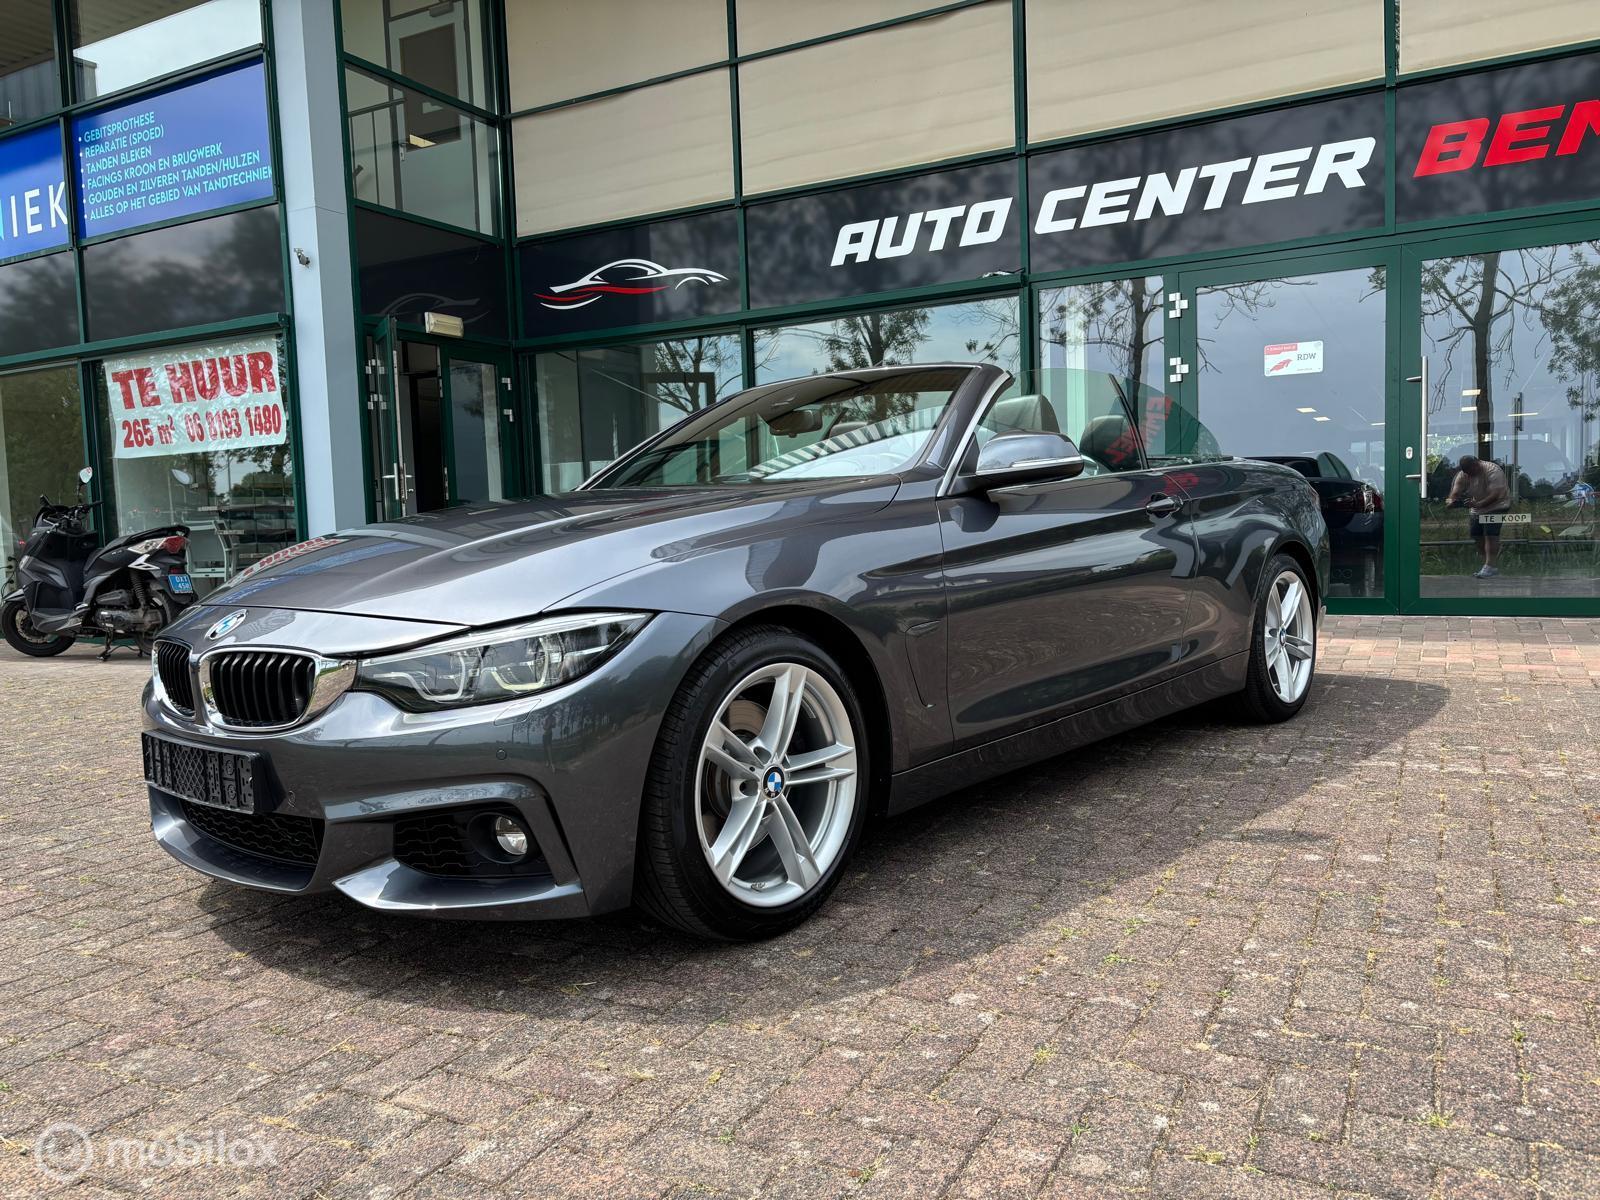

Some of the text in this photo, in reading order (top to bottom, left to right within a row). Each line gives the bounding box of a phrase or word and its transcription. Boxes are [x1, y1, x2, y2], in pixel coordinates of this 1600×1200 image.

[84, 111, 155, 142] GEBITSPROTHESE
[85, 124, 164, 158] REPARATIE (SPOED)
[86, 145, 152, 174] TANDEN BLEKEN
[87, 142, 222, 190] FACINGS KROON EN BRUGWERK
[88, 150, 260, 204] GOUDEN EN ZILVEREN TANDEN/HULZEN
[0, 181, 68, 240] IEK
[90, 204, 114, 221] ALLES
[116, 200, 129, 214] OP
[130, 196, 146, 211] HET
[148, 188, 180, 206] GEBIED
[182, 183, 201, 197] VAN
[830, 197, 1013, 267] AUTO
[1034, 137, 1376, 235] CENTER
[1297, 352, 1317, 361] RDW
[112, 351, 277, 410] TE HUUR
[122, 418, 154, 449] 265
[184, 412, 205, 443] 06
[205, 408, 242, 441] 8193
[244, 403, 282, 436] 1480
[1484, 514, 1527, 523] TE KOOP
